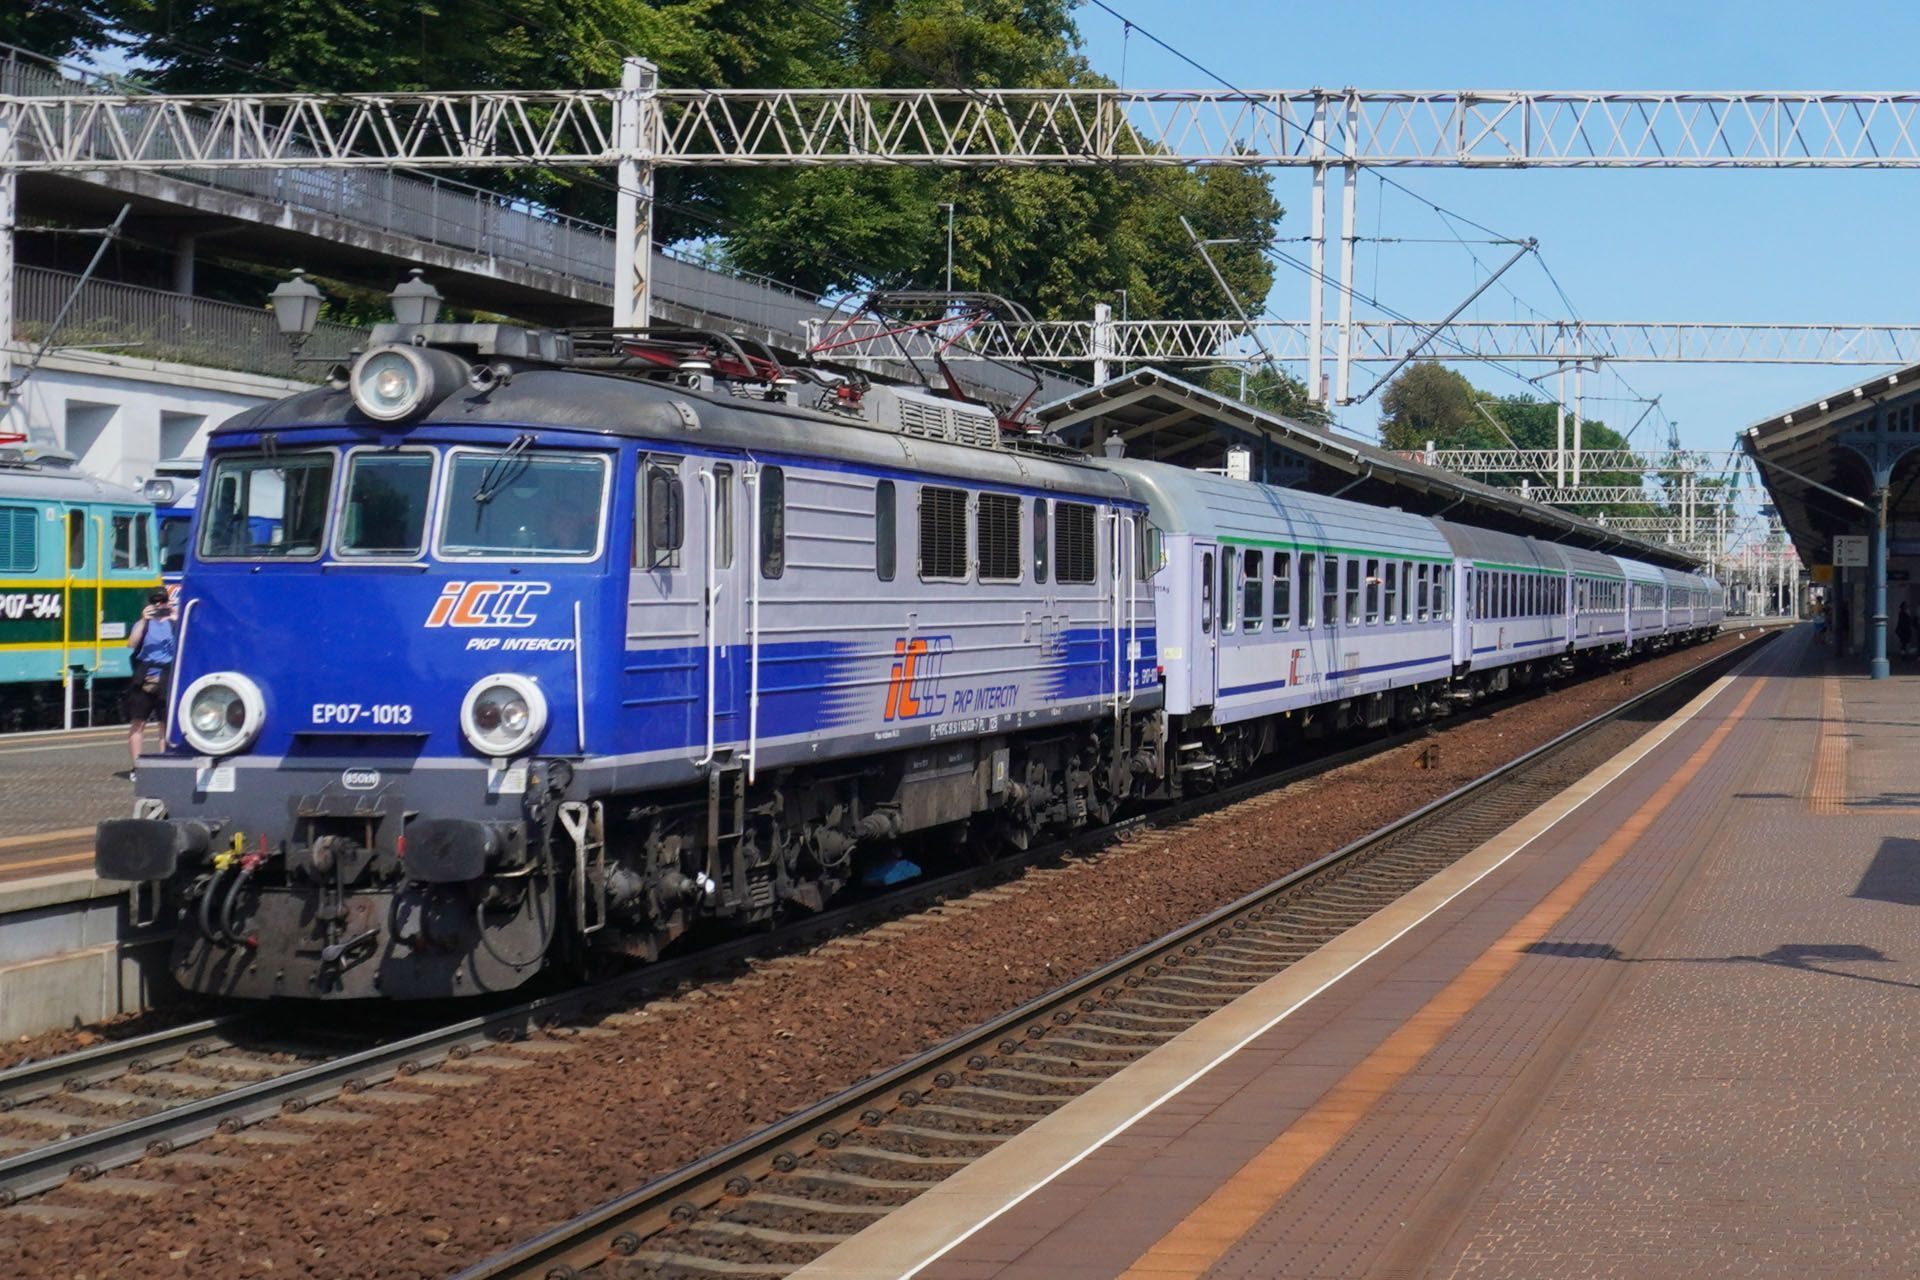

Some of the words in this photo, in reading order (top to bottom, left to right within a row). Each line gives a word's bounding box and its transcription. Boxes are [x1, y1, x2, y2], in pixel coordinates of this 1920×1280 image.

[465, 638, 501, 650] PKP
[501, 638, 577, 651] INTERCITY
[951, 689, 974, 713] PKP
[974, 684, 1020, 711] INTERCITY
[312, 704, 412, 724] EP07-1013
